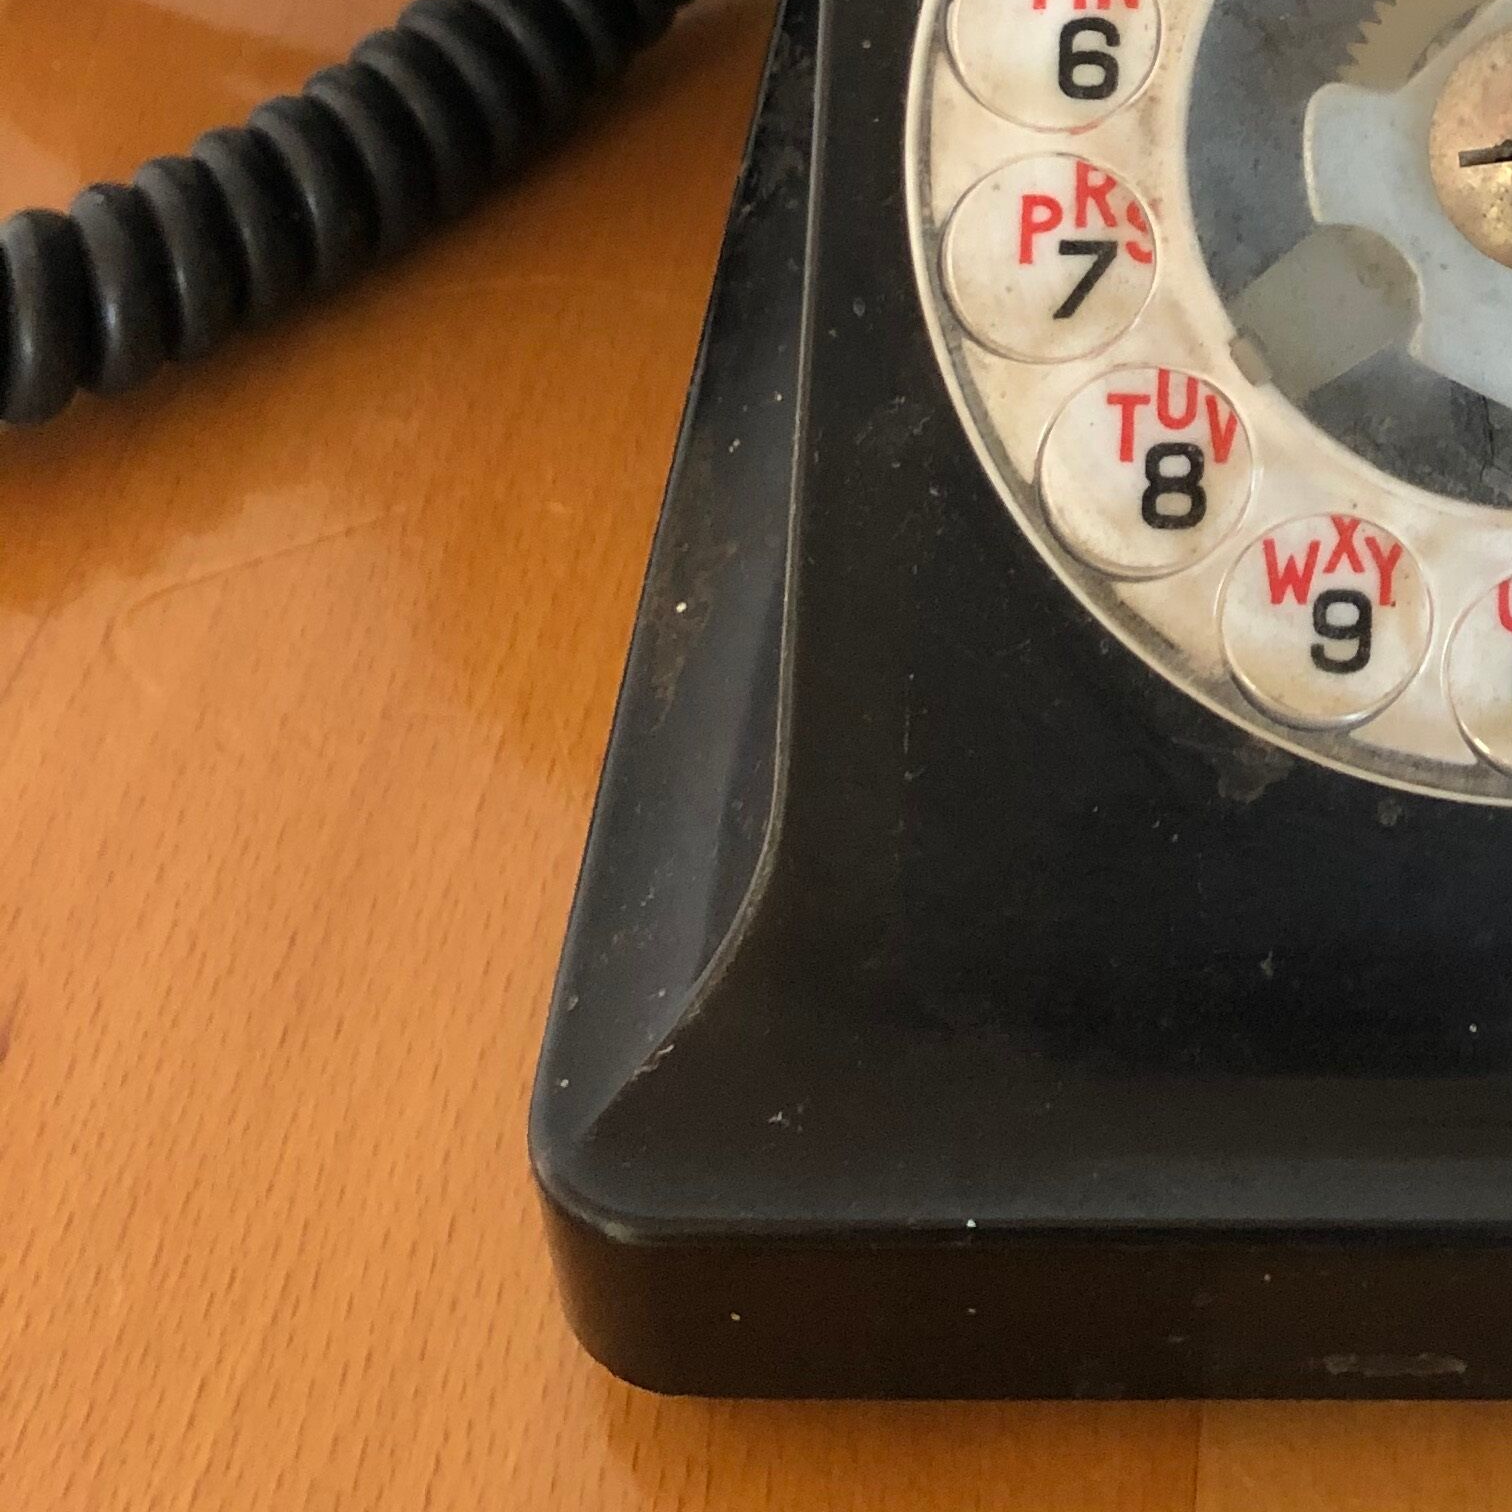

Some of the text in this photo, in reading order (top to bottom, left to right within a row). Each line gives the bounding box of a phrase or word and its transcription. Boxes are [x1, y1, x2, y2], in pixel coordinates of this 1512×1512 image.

[1058, 17, 1120, 100] 6
[1018, 160, 1154, 265] PRS
[1053, 239, 1119, 319] 7
[1106, 367, 1238, 465] TUV
[1141, 442, 1207, 530] 8
[1263, 514, 1404, 607] WXY
[1310, 589, 1372, 674] 9
